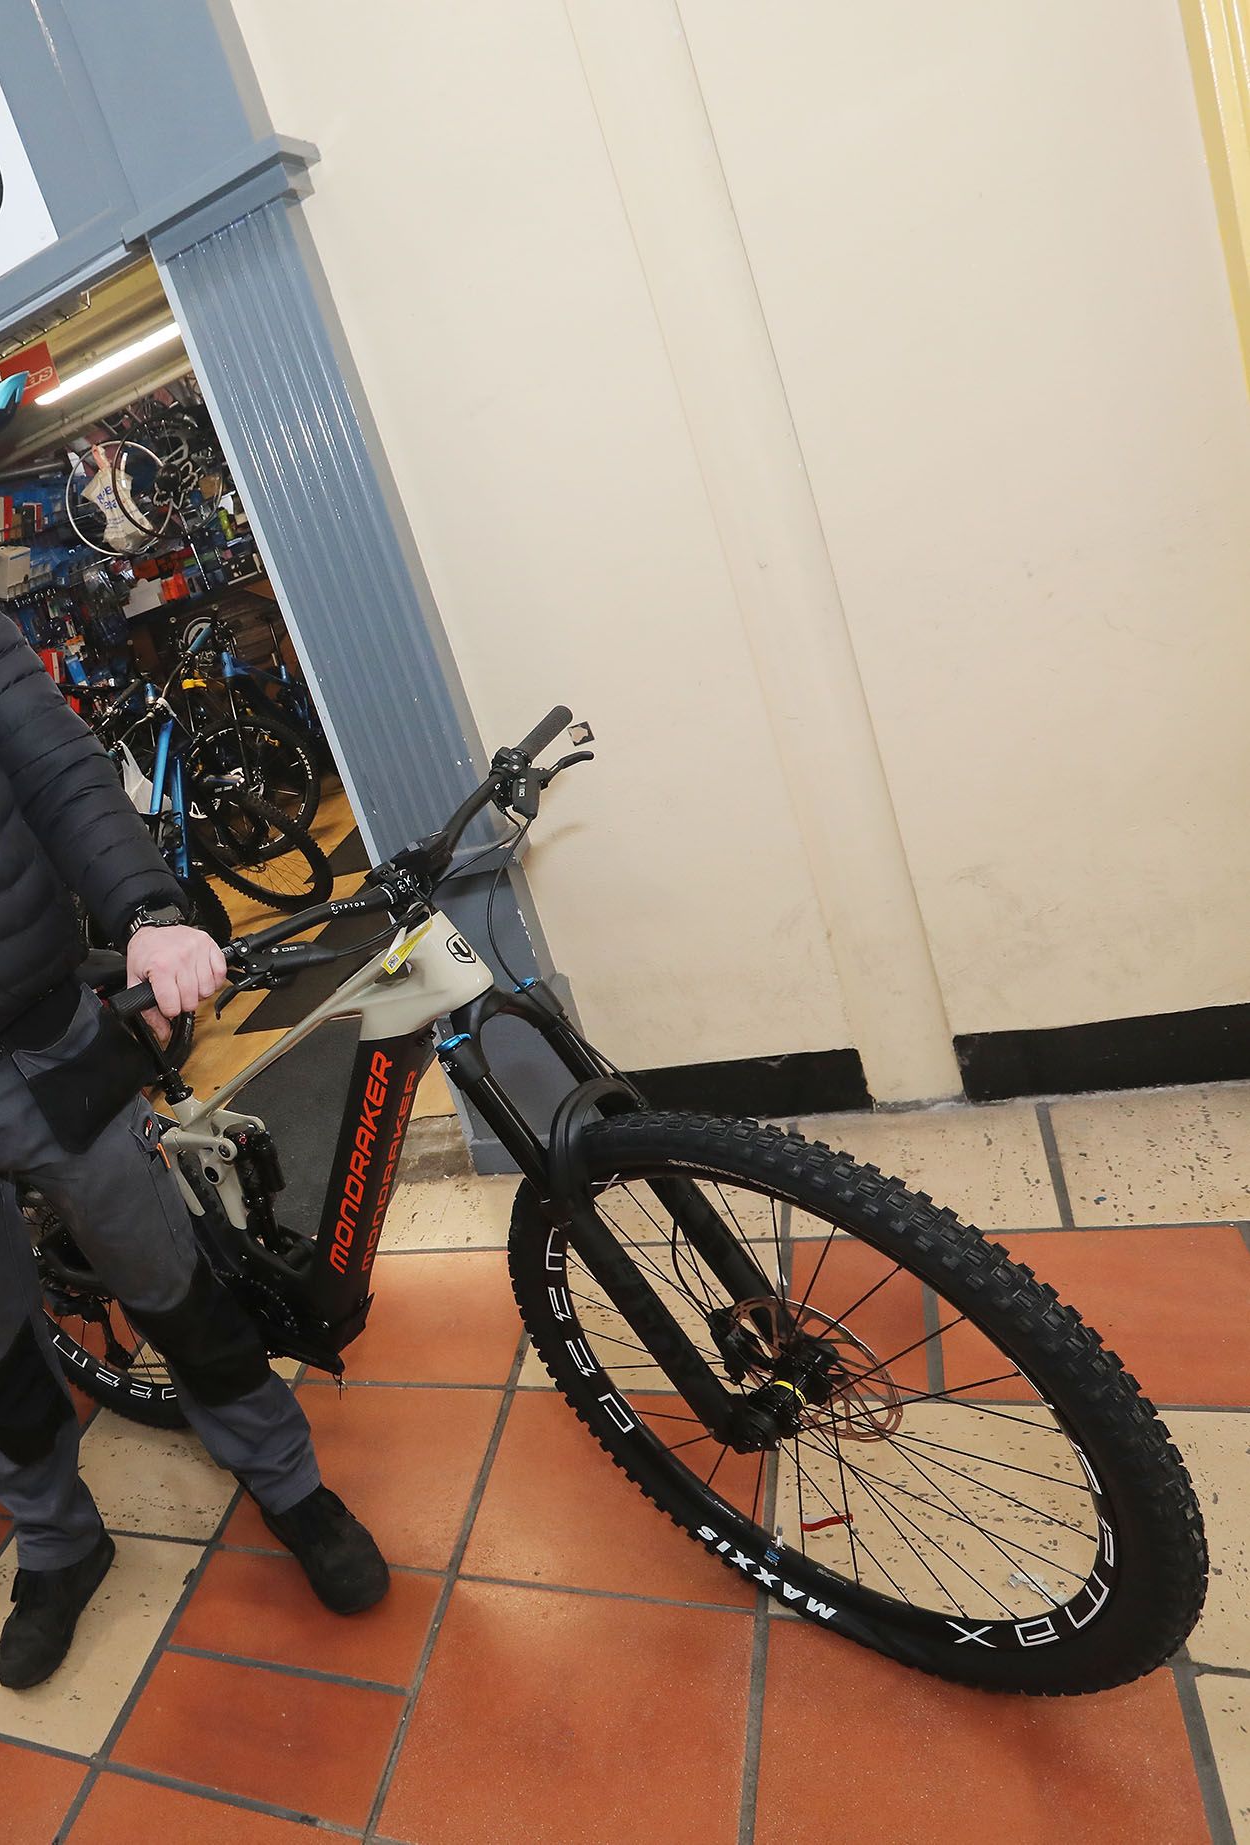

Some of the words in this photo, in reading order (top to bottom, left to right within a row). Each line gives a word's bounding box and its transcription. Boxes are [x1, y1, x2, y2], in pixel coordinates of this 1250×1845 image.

[297, 747, 313, 780] MAXXIS
[329, 1050, 393, 1274] MONDRAKER
[361, 1071, 417, 1271] MONDRAKER
[696, 1525, 839, 1621] MAXXIS
